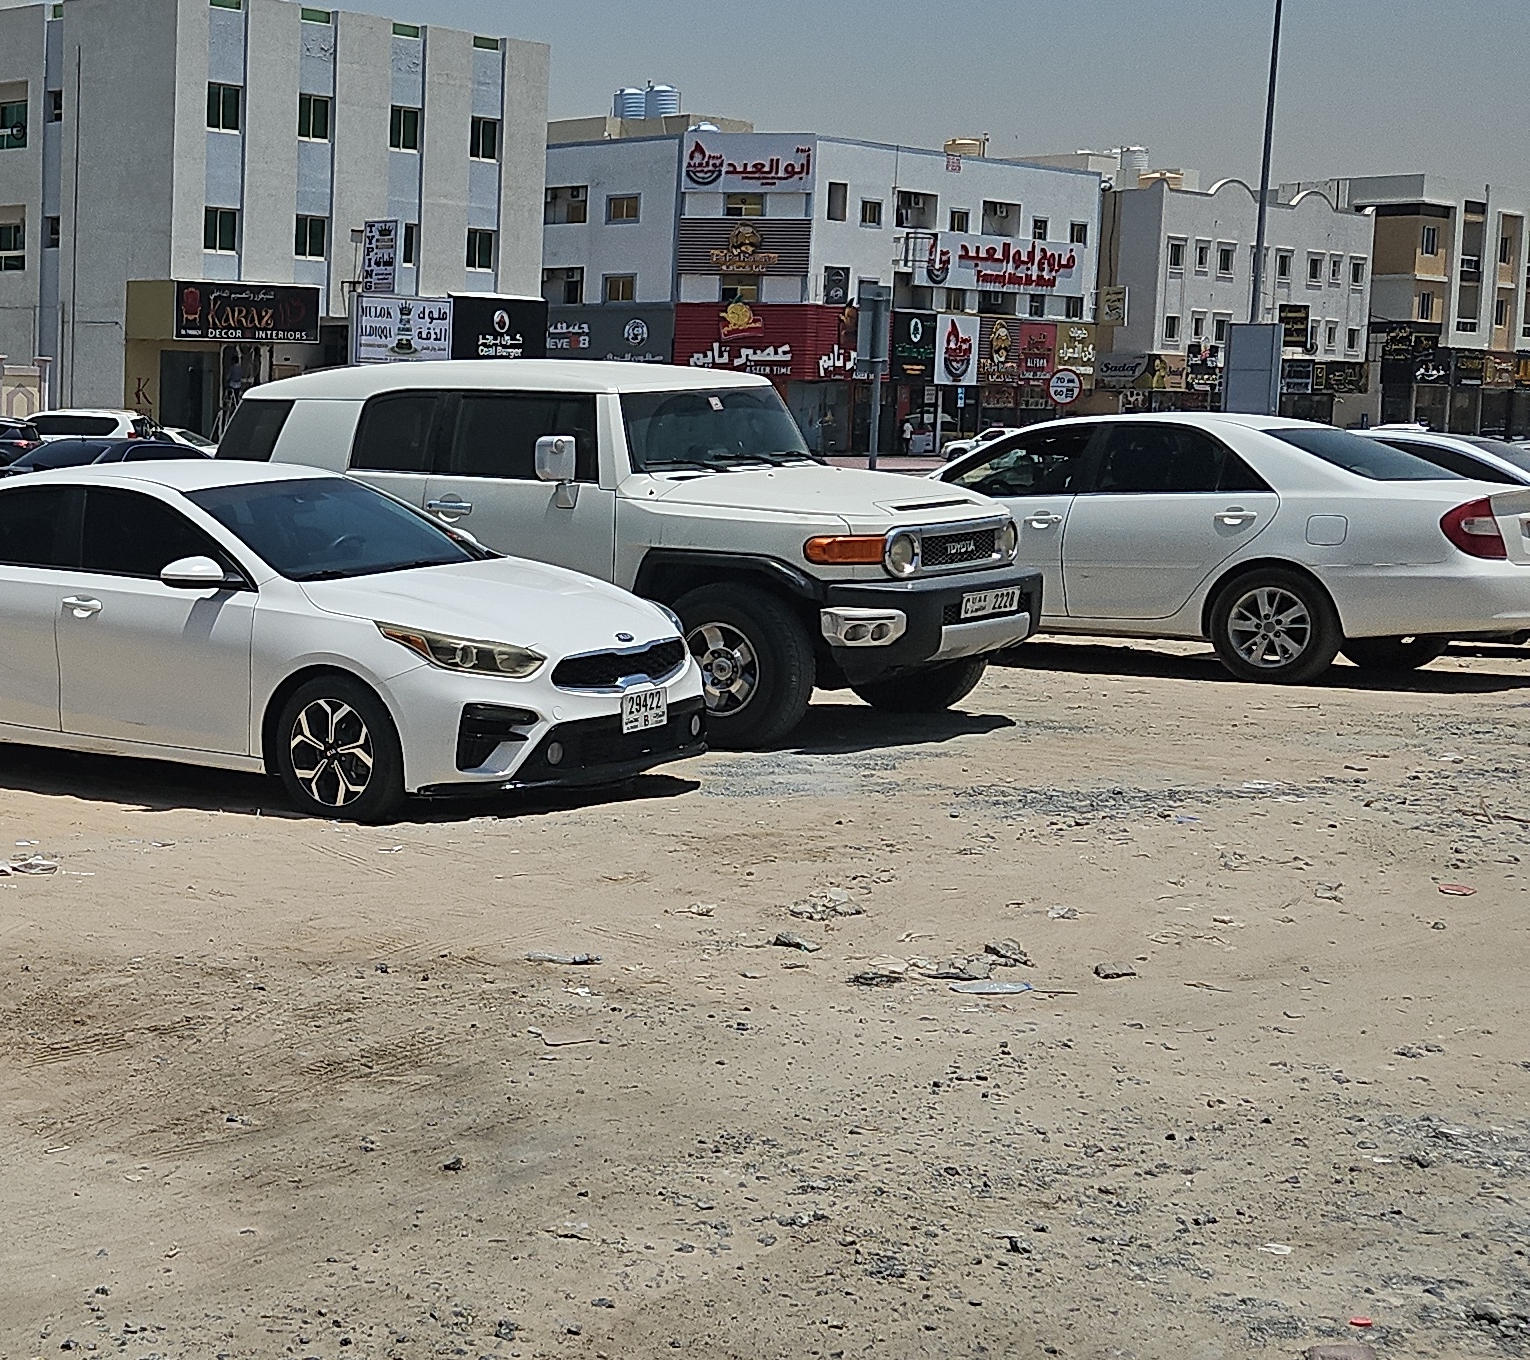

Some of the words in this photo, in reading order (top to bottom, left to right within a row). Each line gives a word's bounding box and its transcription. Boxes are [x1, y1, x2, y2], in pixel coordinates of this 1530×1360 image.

[364, 223, 376, 291] TYPING
[1011, 240, 1036, 271] أبو
[1037, 247, 1076, 274] فروج
[207, 300, 275, 329] KARAZ
[207, 328, 243, 339] DECOR
[255, 330, 308, 340] INTERIORS
[689, 341, 730, 368] تايم
[733, 343, 793, 367] عصير
[745, 365, 770, 374] ASEER
[773, 365, 792, 375] TIME
[1100, 362, 1142, 375] Sadaf
[1055, 376, 1066, 384] 70
[1053, 389, 1065, 397] 60
[945, 539, 976, 555] TOYOTA
[991, 590, 1016, 611] 2228
[628, 690, 662, 716] 29422
[643, 714, 650, 727] B
